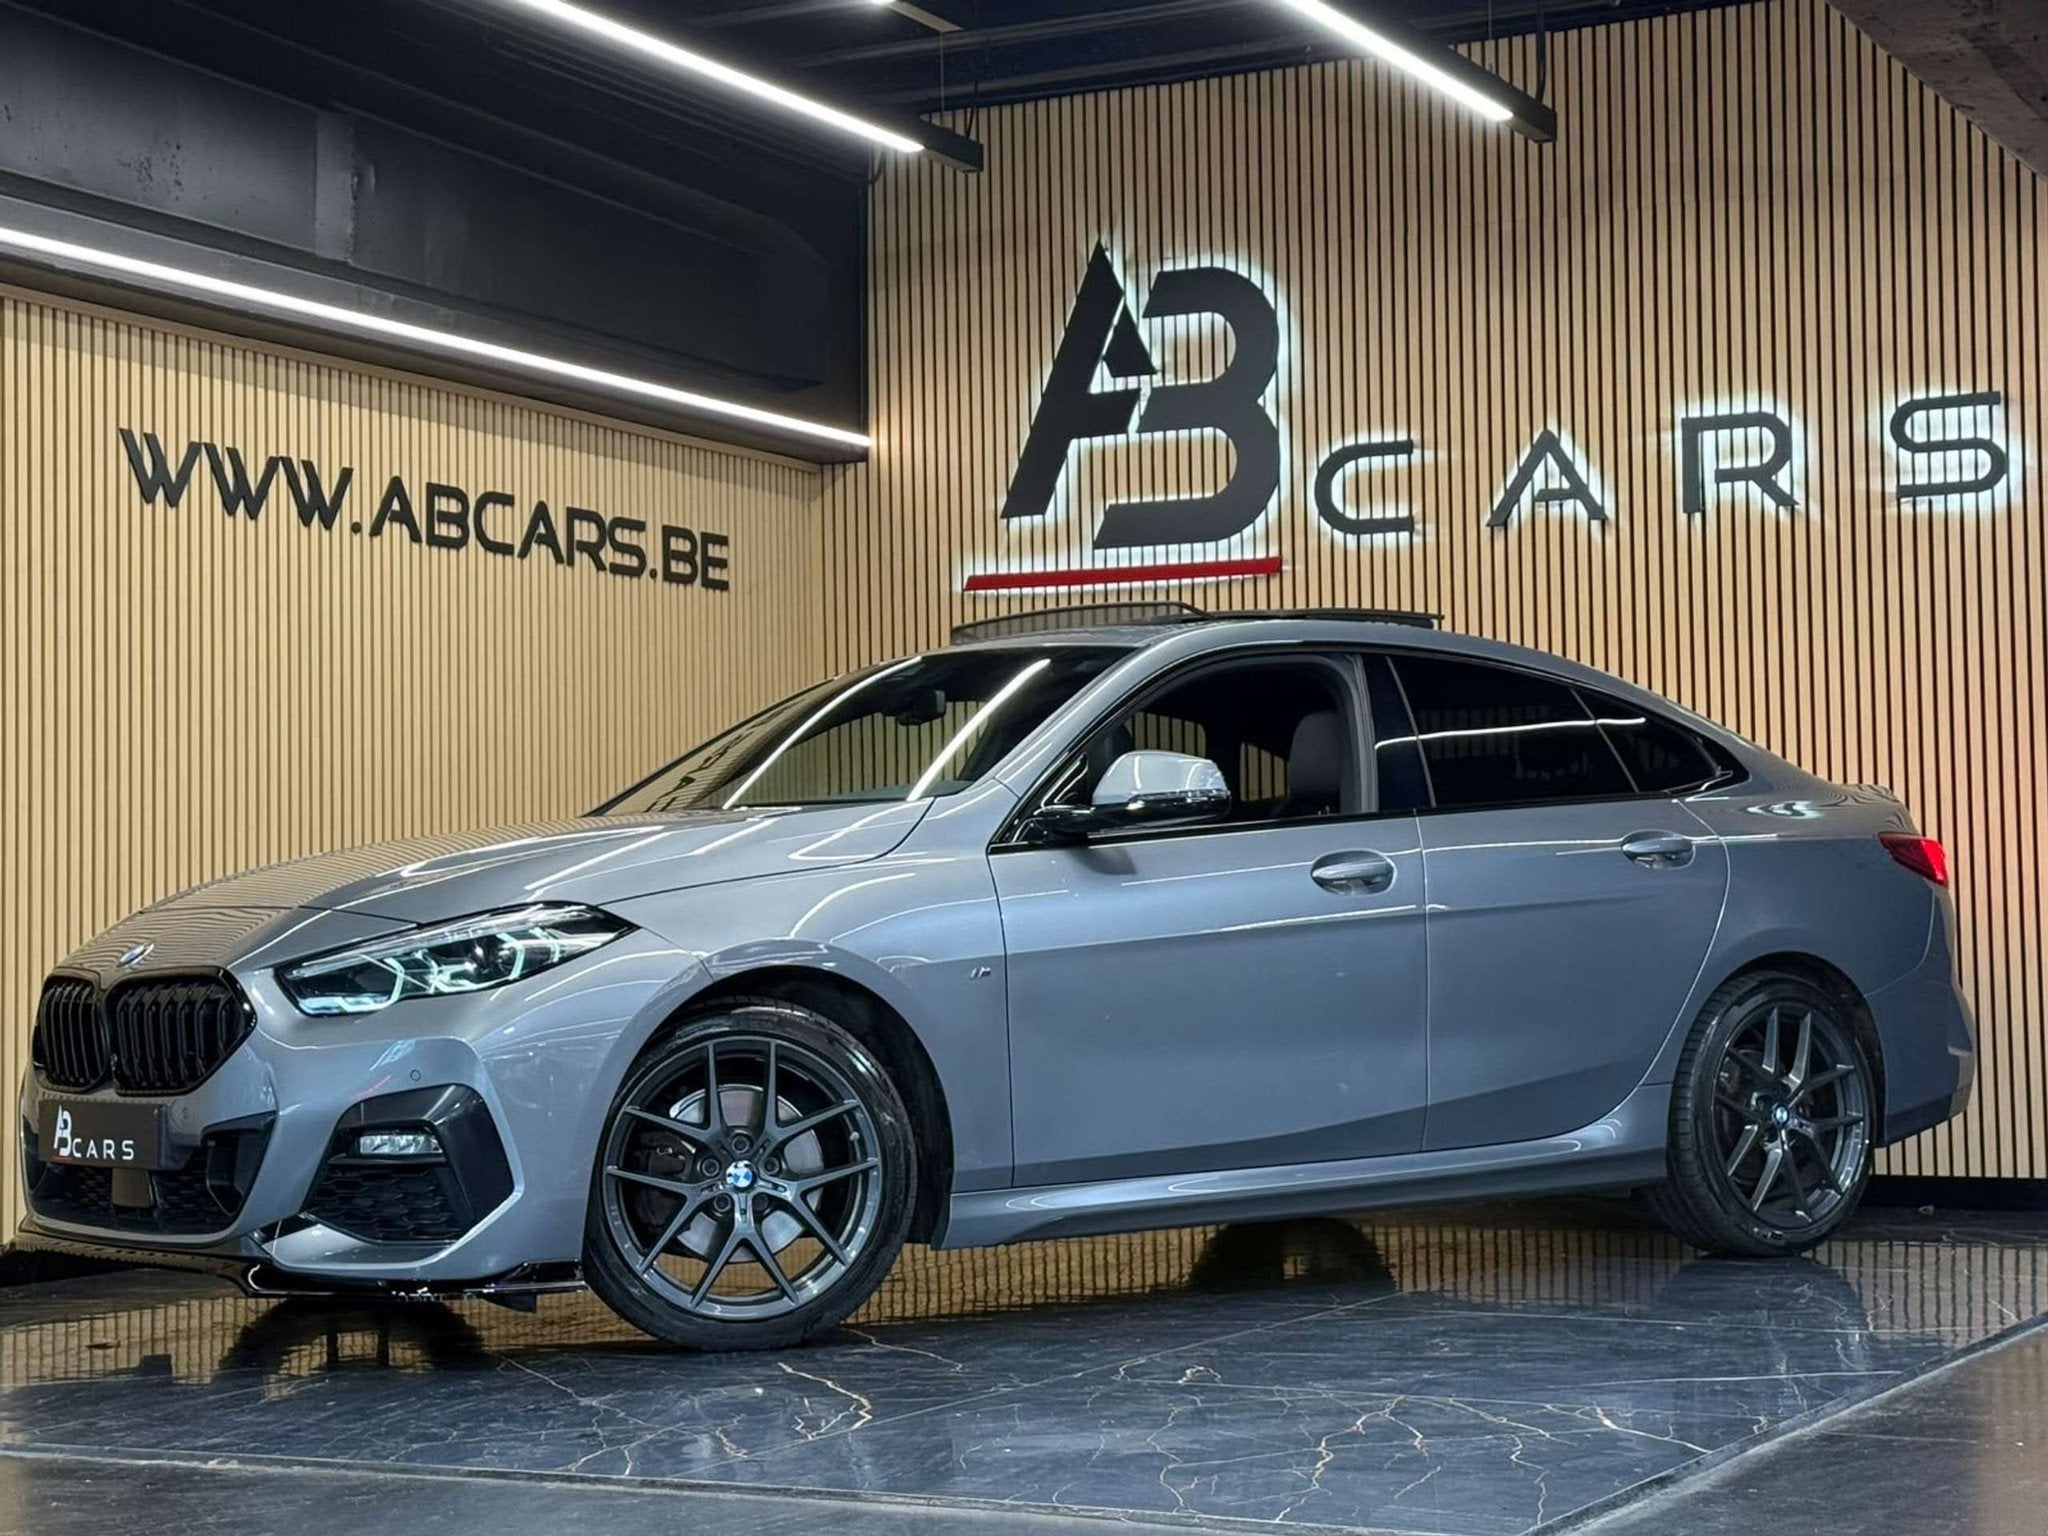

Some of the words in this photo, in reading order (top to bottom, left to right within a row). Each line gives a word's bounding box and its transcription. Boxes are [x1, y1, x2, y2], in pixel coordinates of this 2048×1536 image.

[1000, 239, 1280, 549] AB
[1314, 391, 2008, 535] CARS
[118, 428, 730, 591] WWW.ABCARS.BE
[73, 1138, 135, 1161] CARS
